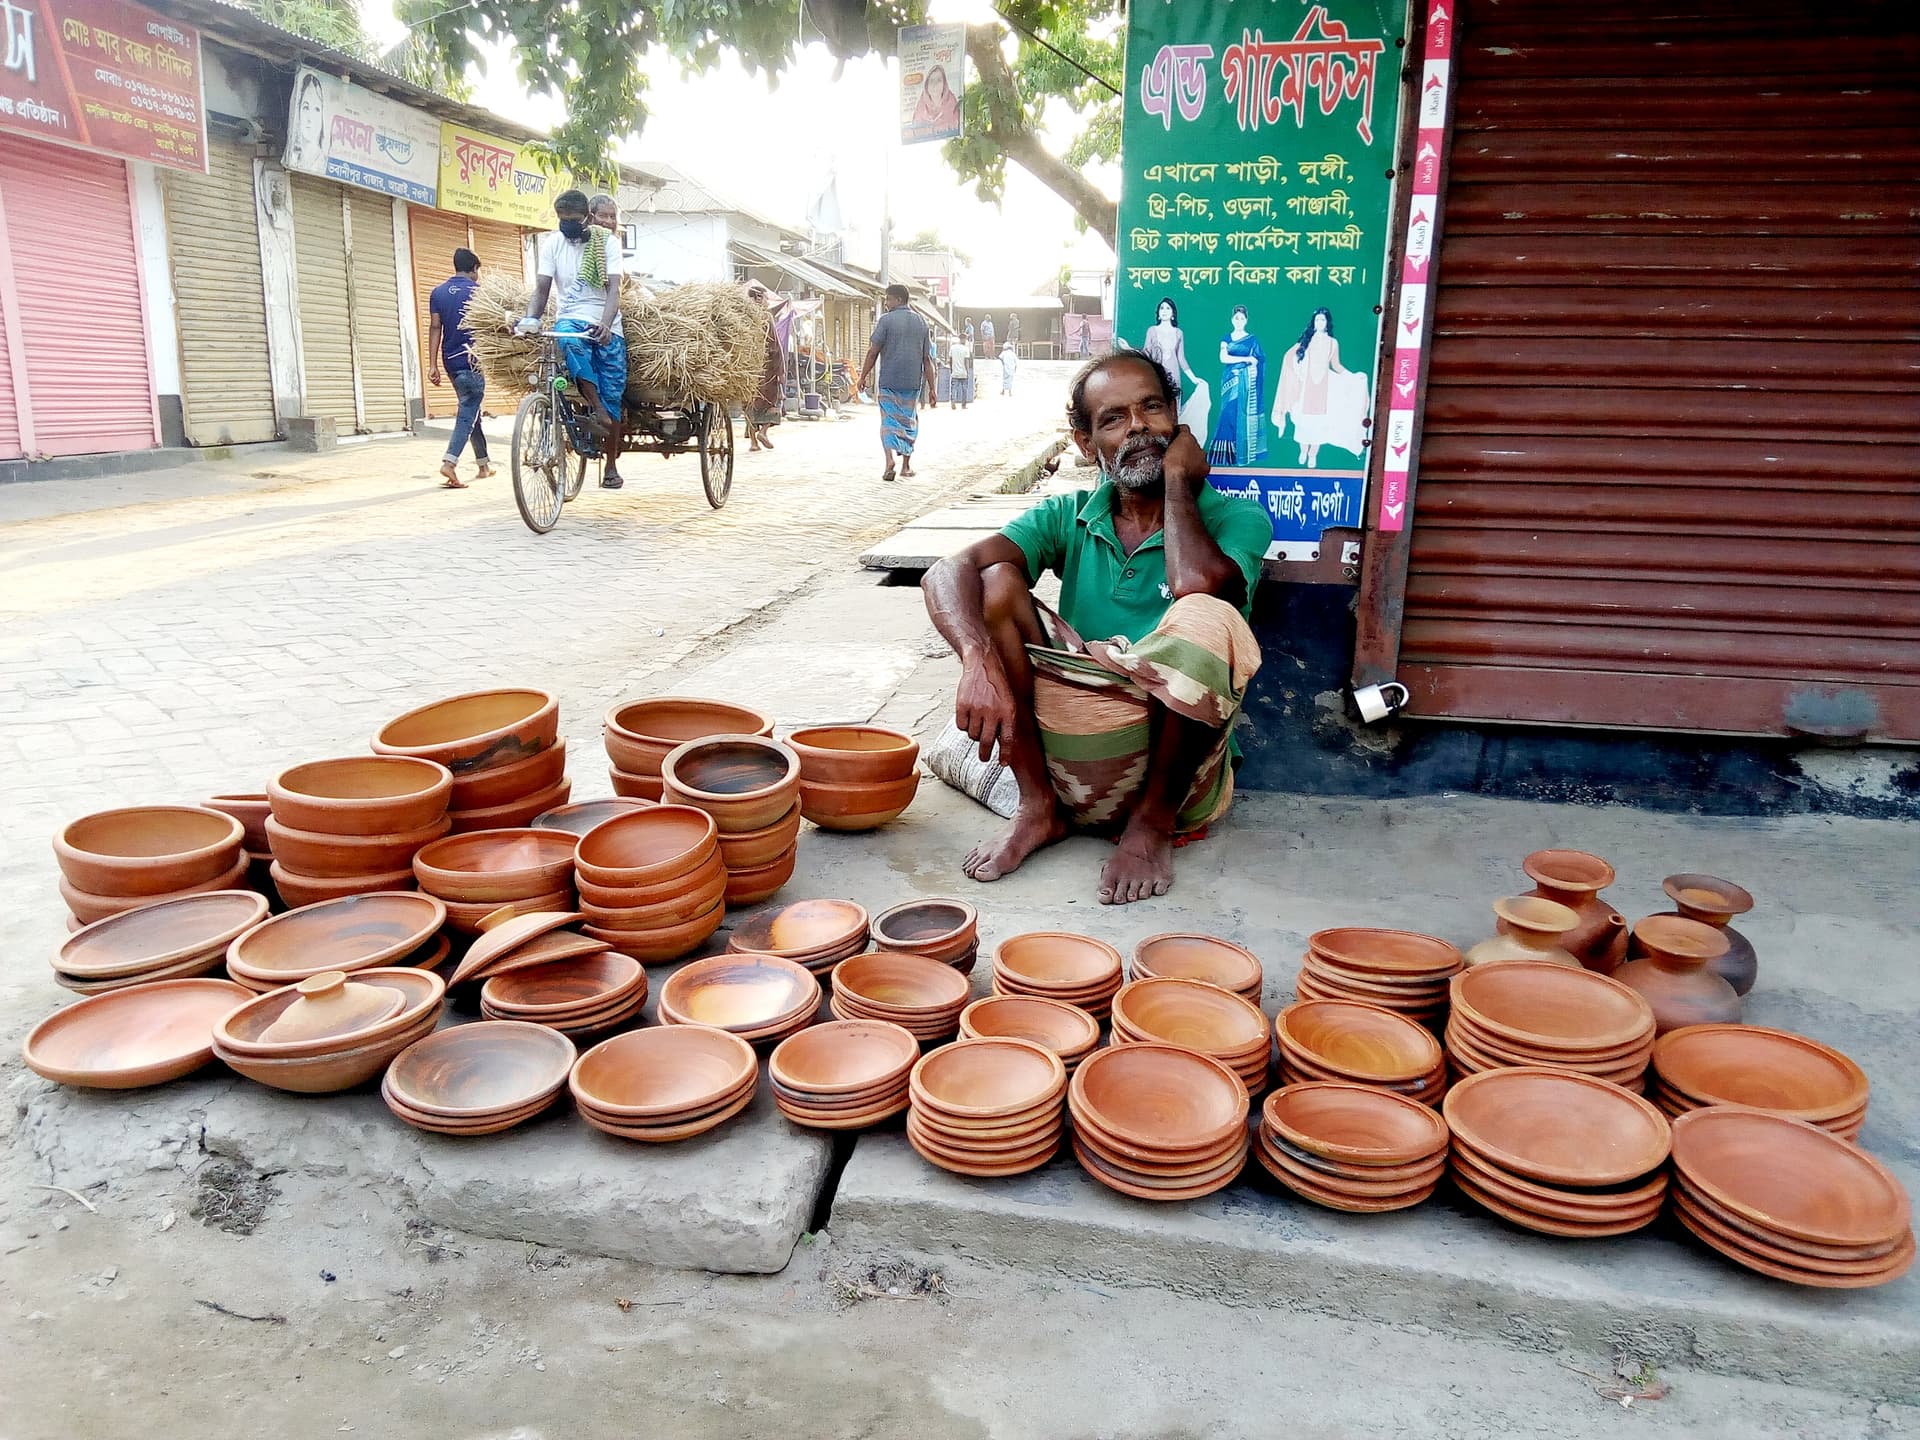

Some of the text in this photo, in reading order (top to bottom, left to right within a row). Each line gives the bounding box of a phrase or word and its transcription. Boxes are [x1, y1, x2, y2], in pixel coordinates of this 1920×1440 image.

[1434, 22, 1446, 47] bKash
[1429, 90, 1441, 116] bKash
[455, 136, 515, 191] বুলবুল
[1143, 162, 1219, 184] এখানে
[1421, 158, 1433, 184] bKash
[1130, 227, 1162, 254] ছিট
[1167, 231, 1221, 255] কাপড়
[1307, 224, 1364, 252] সামগ্রী
[1415, 225, 1426, 250] bKash
[1128, 266, 1173, 289] সুলভ
[1178, 266, 1223, 291] মূল্যে
[1227, 261, 1280, 285] বিক্রয়
[1285, 264, 1322, 285] করা
[1399, 359, 1411, 382] bKash
[1267, 481, 1307, 527] আত্রাই,
[1388, 481, 1399, 504] bKash
